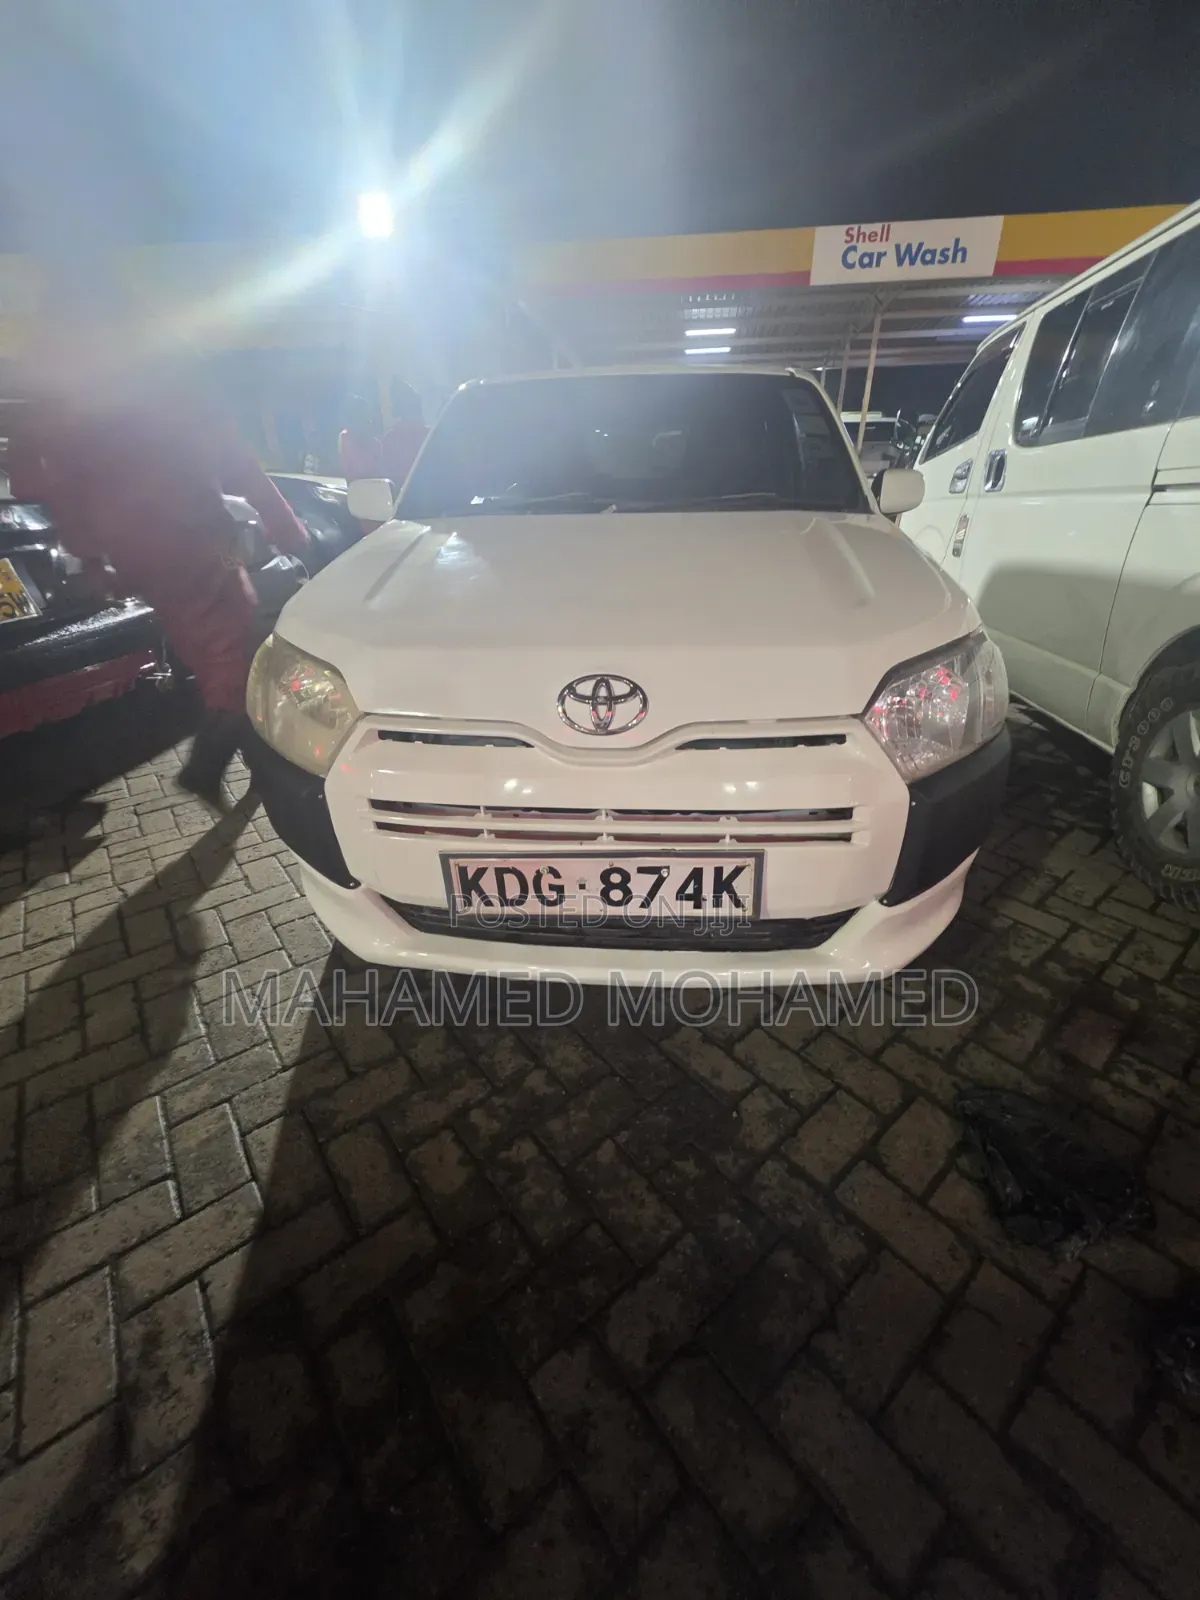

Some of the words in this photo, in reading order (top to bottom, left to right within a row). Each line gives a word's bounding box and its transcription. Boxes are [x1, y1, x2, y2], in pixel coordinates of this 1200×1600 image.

[844, 223, 891, 244] Shell
[841, 245, 887, 270] Car
[895, 237, 968, 267] Wash
[457, 865, 565, 908] KDG
[599, 865, 751, 909] 874K
